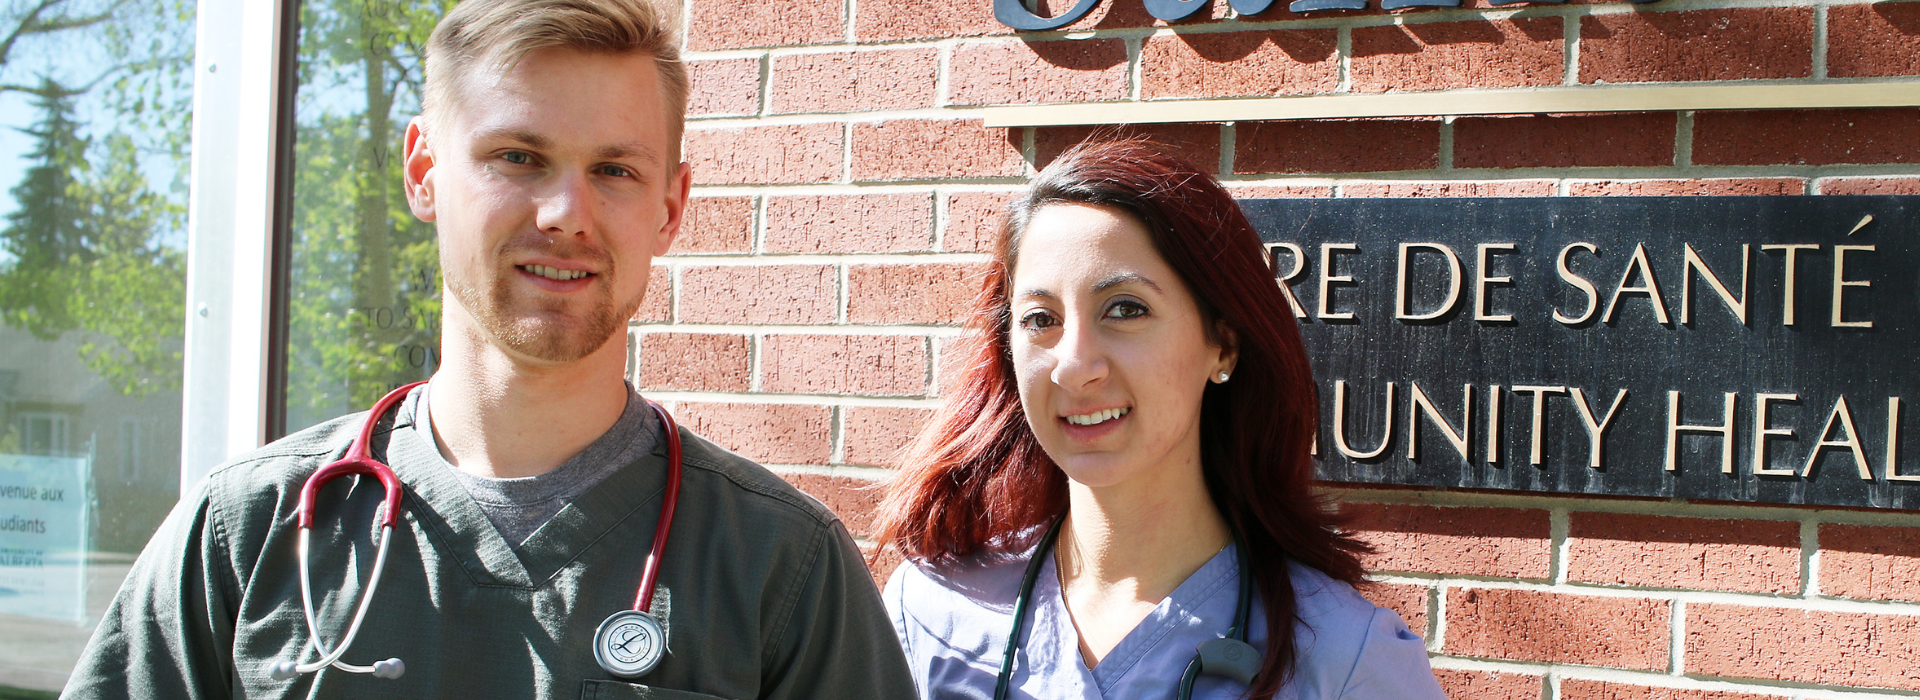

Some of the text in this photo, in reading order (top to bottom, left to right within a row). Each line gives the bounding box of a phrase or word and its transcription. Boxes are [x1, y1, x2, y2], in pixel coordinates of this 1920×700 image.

[1396, 242, 1516, 323] DE
[1553, 214, 1876, 329] SANTÉ
[1311, 379, 1920, 482] UNITY HEAL
[40, 487, 64, 502] aux
